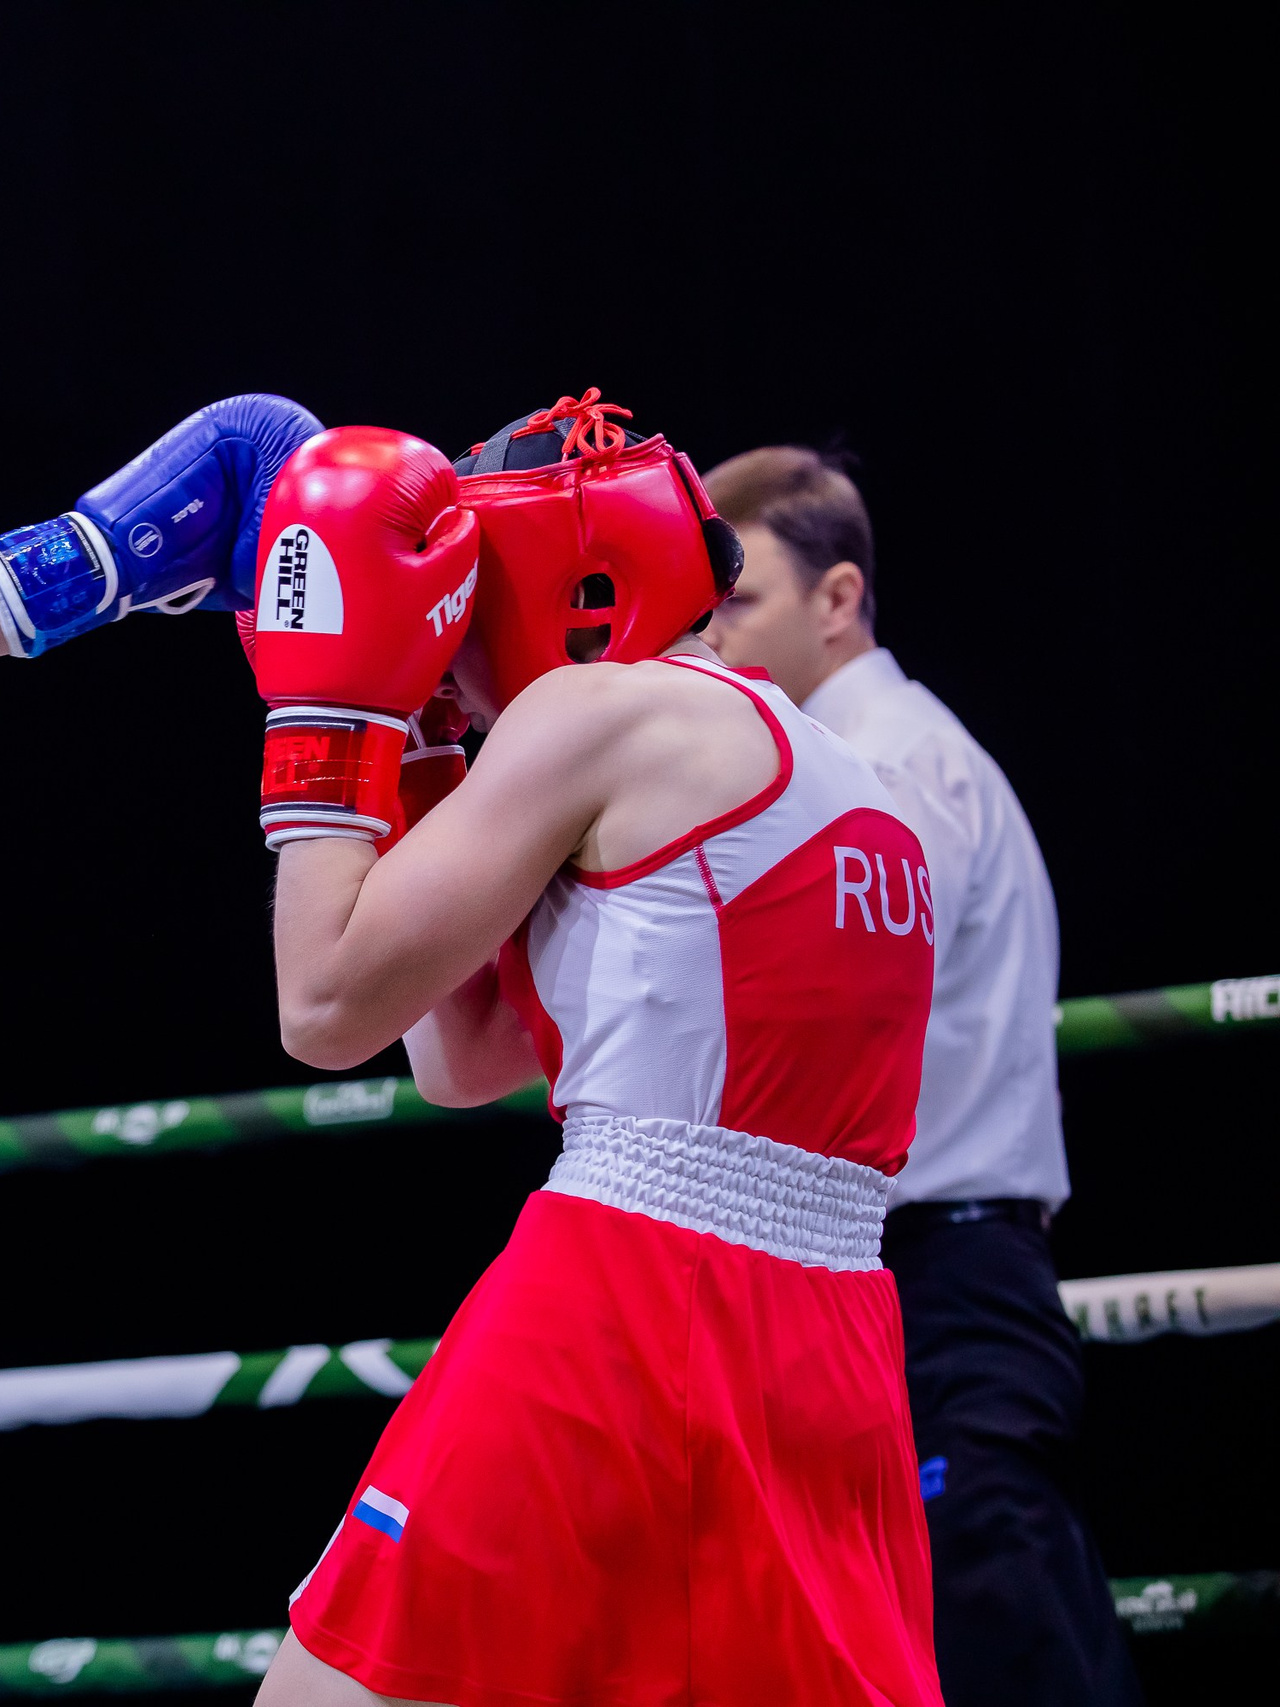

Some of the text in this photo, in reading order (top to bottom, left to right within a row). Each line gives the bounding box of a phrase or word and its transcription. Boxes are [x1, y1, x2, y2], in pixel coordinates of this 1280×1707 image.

[276, 538, 295, 620] HILL
[291, 529, 310, 629] GREEN
[426, 557, 478, 637] Tige
[833, 845, 934, 946] RUS
